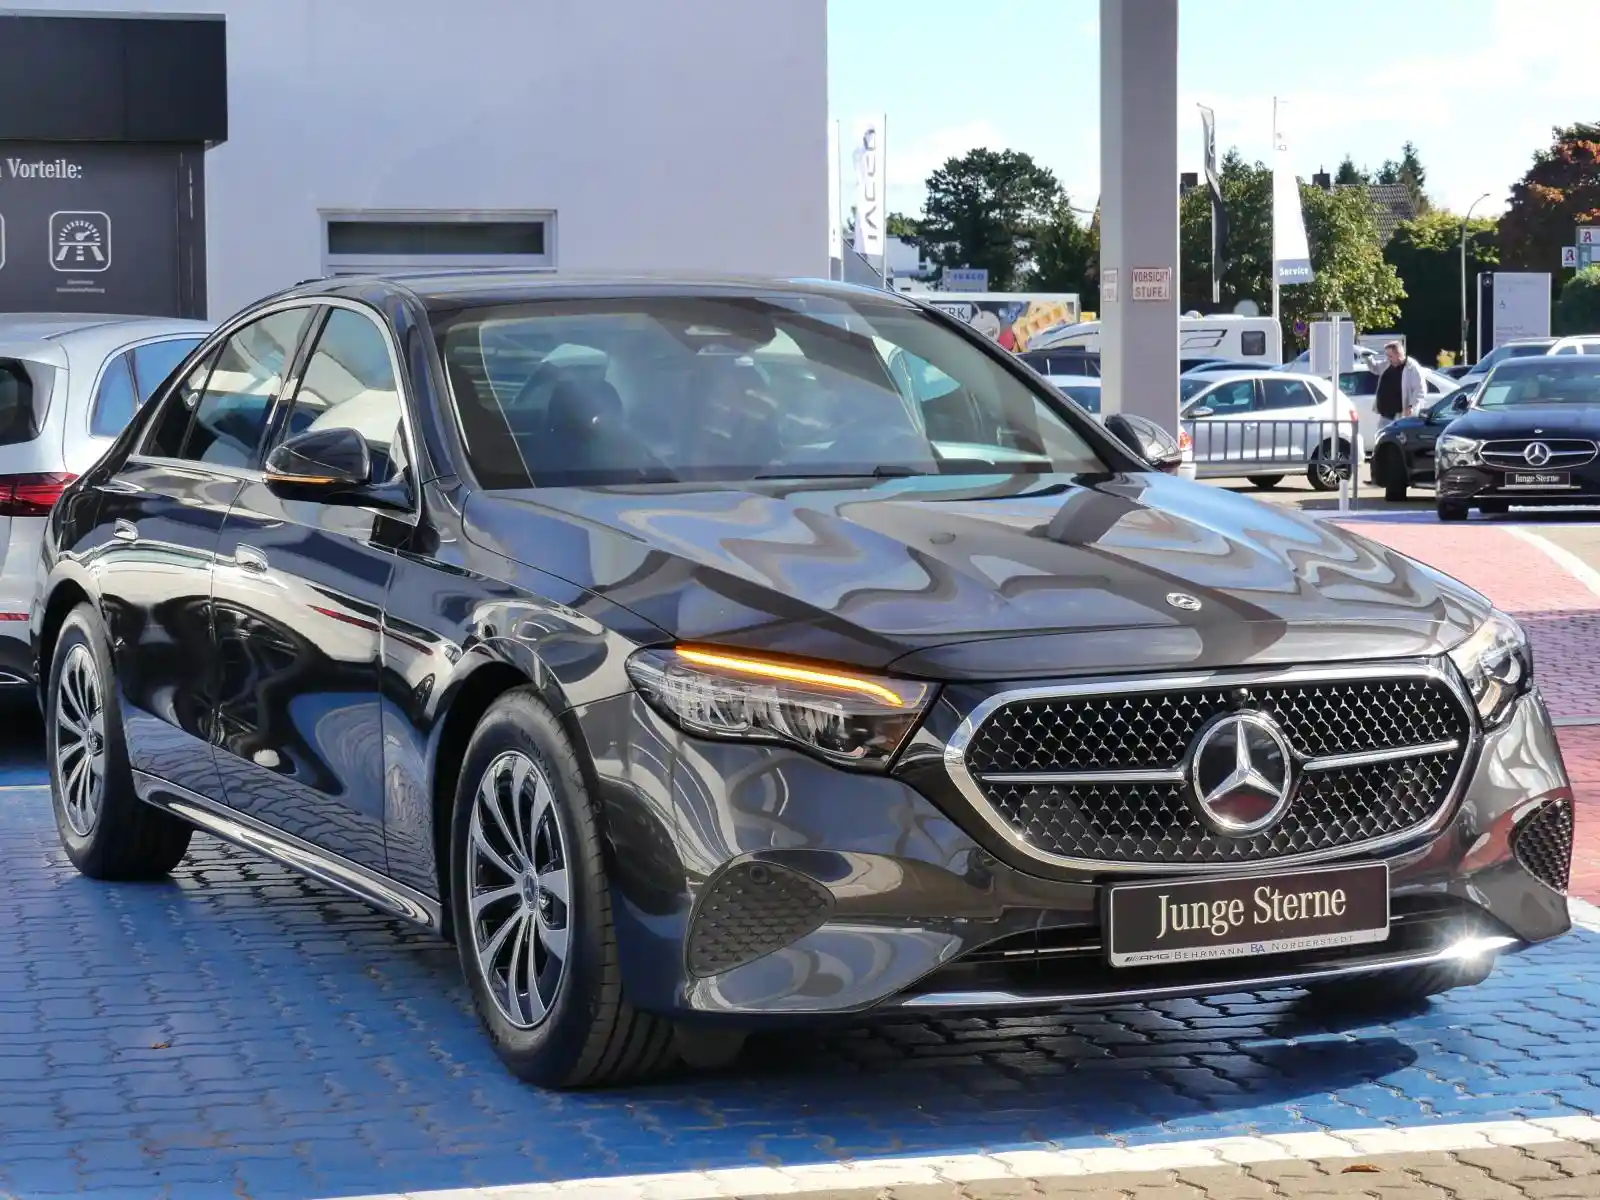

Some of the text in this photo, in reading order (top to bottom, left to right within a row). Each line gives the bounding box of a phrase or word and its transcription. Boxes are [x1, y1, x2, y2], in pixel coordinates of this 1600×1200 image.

[6, 158, 83, 179] Vorteile:
[1133, 271, 1169, 282] VORSICHT
[1279, 267, 1309, 277] Service
[1515, 474, 1560, 483] Junge Sterne
[1156, 886, 1347, 939] Junge Sterne
